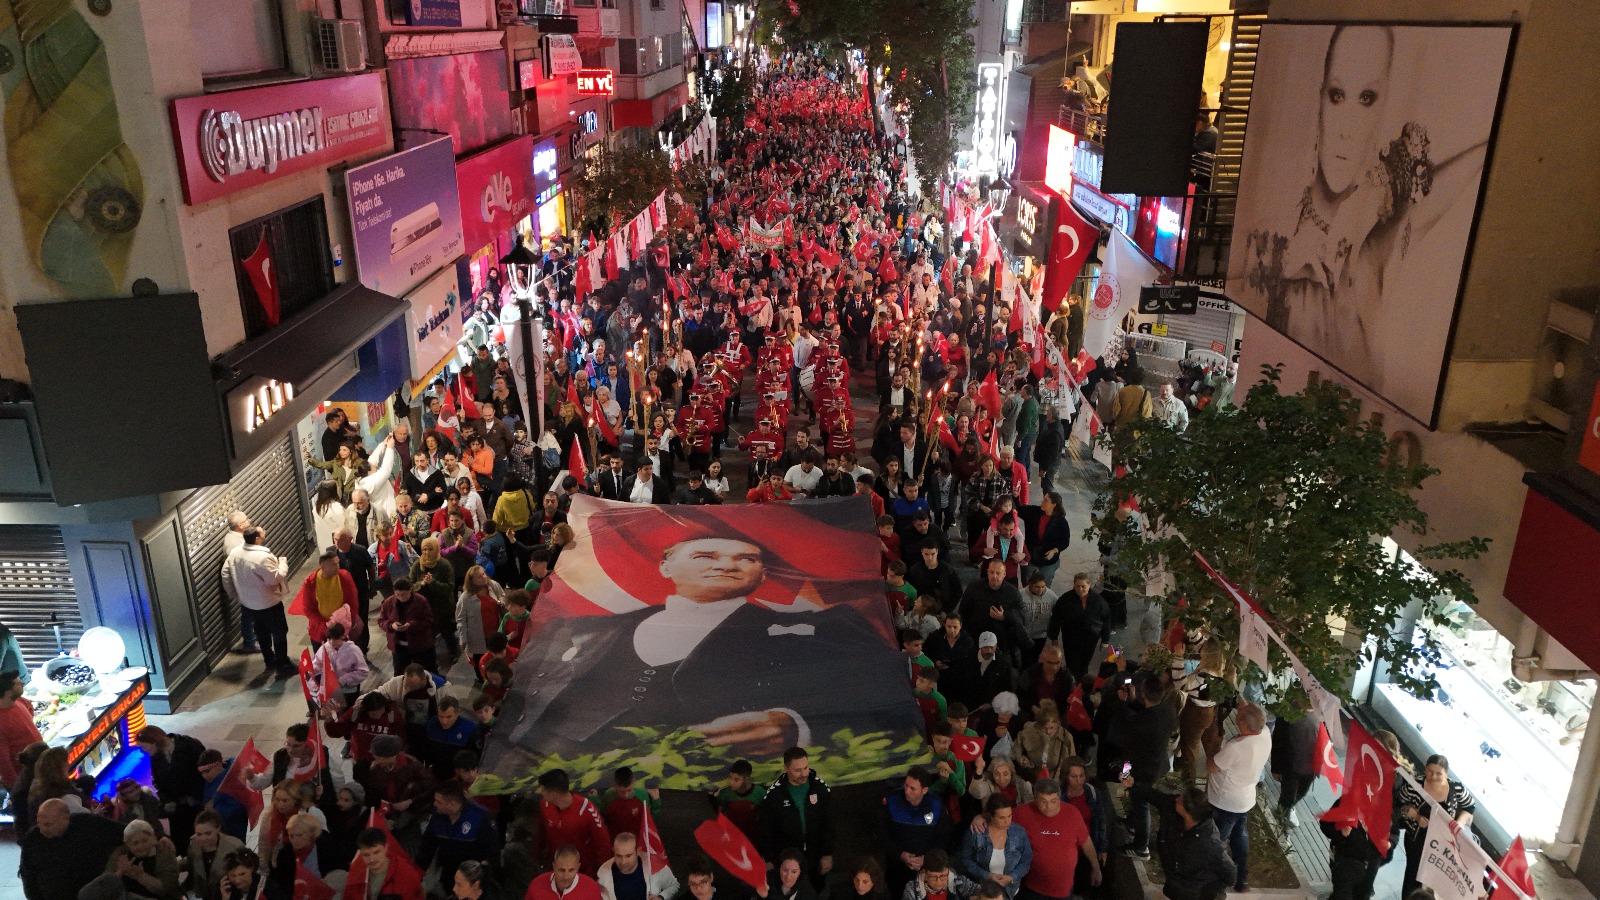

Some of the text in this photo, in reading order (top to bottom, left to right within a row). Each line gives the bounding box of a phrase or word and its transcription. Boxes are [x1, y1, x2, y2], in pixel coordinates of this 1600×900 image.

[217, 106, 323, 175] Duymer
[352, 179, 374, 196] iPhone
[374, 173, 386, 188] 16e.
[355, 197, 374, 217] Fiyatı
[109, 682, 145, 721] ERKAN
